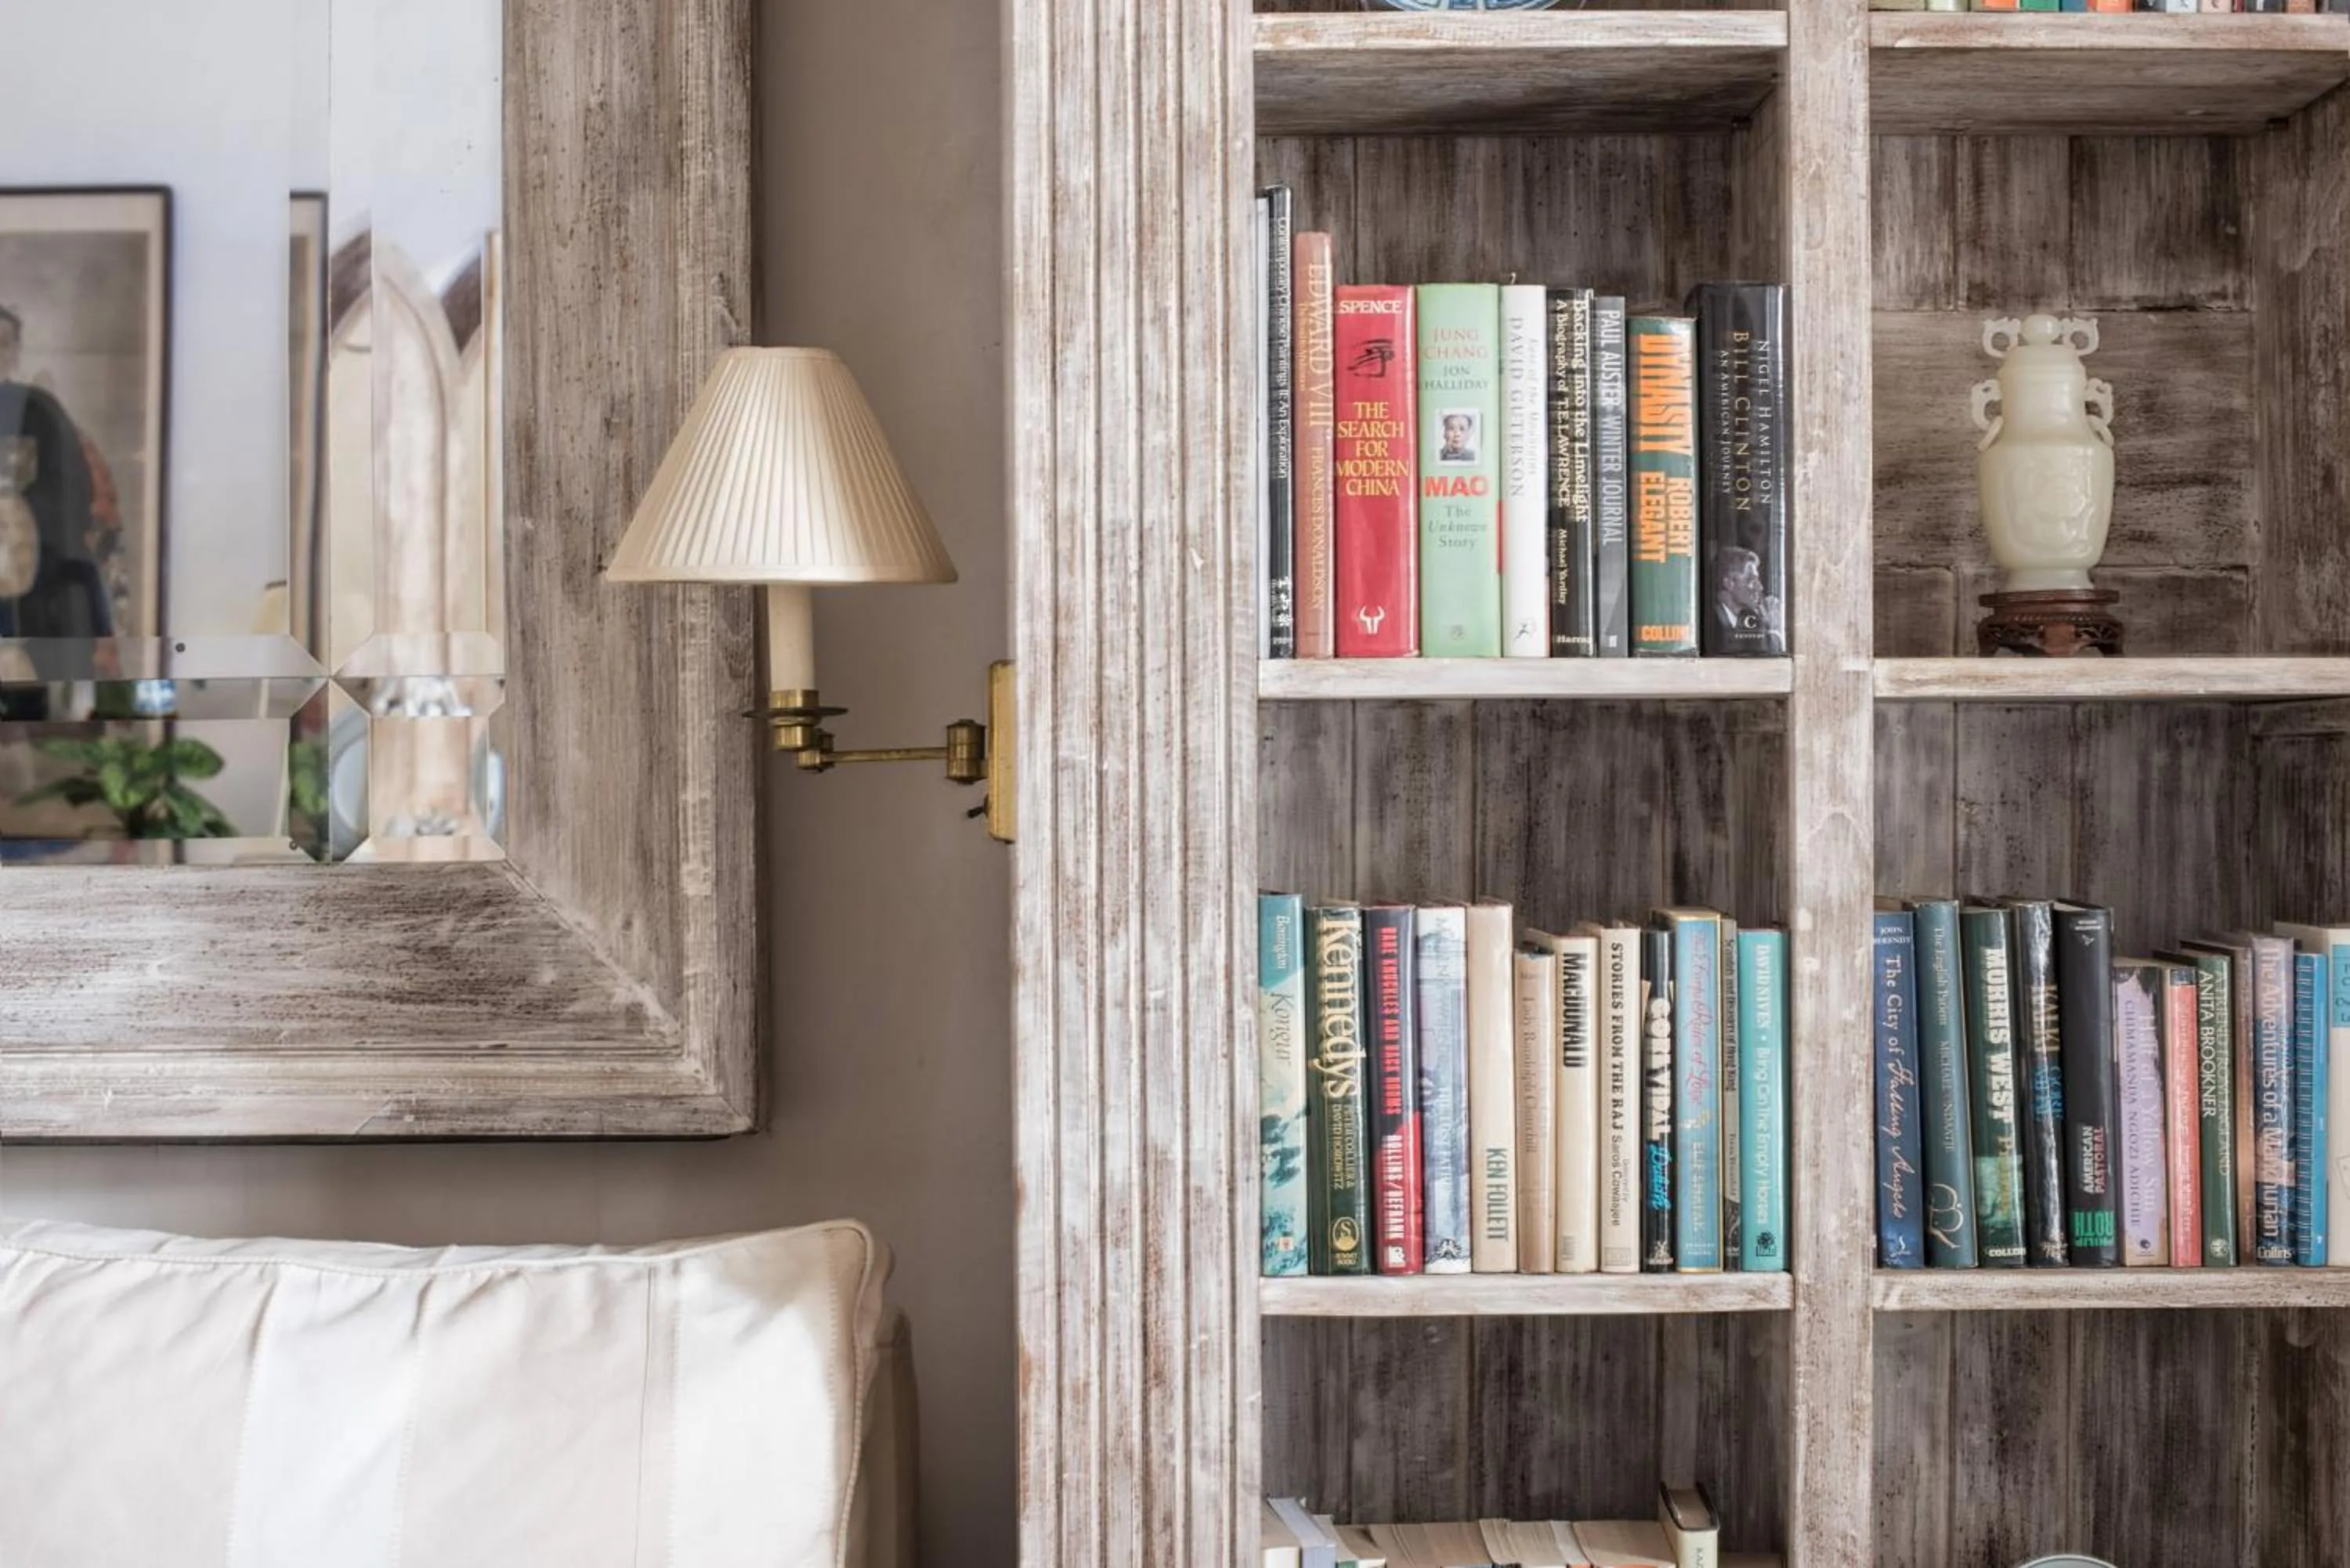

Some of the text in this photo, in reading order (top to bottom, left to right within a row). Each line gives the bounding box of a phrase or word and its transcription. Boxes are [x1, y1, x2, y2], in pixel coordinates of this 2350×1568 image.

[1339, 300, 1402, 313] SPENCE
[1556, 300, 1569, 311] A
[1309, 263, 1333, 427] EDWARD VIII
[1423, 347, 1488, 359] CHANG
[1434, 327, 1479, 342] JUNG
[1555, 314, 1569, 377] Biography
[1421, 379, 1488, 390] HALLIDAY
[1442, 365, 1472, 378] JON
[1559, 379, 1569, 392] of
[1354, 402, 1389, 418] THE
[1509, 316, 1525, 497] DAVID GUTERSON
[1572, 299, 1590, 522] Backing into the Limelight
[1640, 334, 1693, 457] DYNASTY
[1337, 421, 1405, 438] SEARCH
[1600, 310, 1625, 546] PAUL AUSTER WINTER JOURNAL
[1720, 351, 1731, 494] AN AMERICAN JOURNEY
[1733, 331, 1752, 511] BILL CLINTON
[1758, 341, 1773, 504] NIGEL HAMILTON
[1277, 420, 1289, 479] Exploration
[1336, 460, 1409, 477] MODERN
[1356, 439, 1389, 457] FOR
[1346, 479, 1400, 497] CHINA
[1424, 476, 1488, 497] MAO
[1311, 446, 1325, 611] FRANCES DONALDSON
[1427, 520, 1487, 532] Unknown
[1446, 505, 1472, 518] The
[1640, 471, 1667, 563] ELEGANT
[1667, 477, 1694, 558] ROBERT
[1439, 536, 1476, 549] Story
[1558, 529, 1568, 567] Michael
[1933, 926, 1945, 947] The
[1611, 942, 1623, 1010] STORIES
[1755, 945, 1771, 985] DAVID
[1932, 950, 1949, 987] English
[1313, 918, 1366, 1097] Kennedys
[1380, 927, 1403, 1115] BARE KNUCKLES AND BACK ROOMS
[1756, 987, 1772, 1028] NIVEN
[1611, 1015, 1624, 1057] FROM
[1985, 948, 2016, 1123] MORRIS WEST
[2200, 970, 2217, 1118] ANITA BROOKNER
[1611, 1061, 1624, 1094] THE
[1757, 1083, 1771, 1105] On
[1882, 954, 1915, 1218] The City of Falling Angels
[2261, 948, 2285, 1237] The Adventures of a Manchurian
[1332, 1104, 1343, 1135] DAVID
[1611, 1098, 1624, 1130] RAJ
[1650, 1069, 1672, 1141] VIDAL
[2124, 1000, 2142, 1227] CHIMAMANDA NGOZI ADICHIE
[1611, 1134, 1622, 1168] Saros
[1752, 1133, 1771, 1176] Empty
[2140, 1104, 2161, 1166] Yellow
[2081, 1125, 2094, 1194] AMERICAN
[2093, 1125, 2106, 1194] PASTORAL
[1486, 1147, 1509, 1242] KEN FOLLETT
[2142, 1176, 2162, 1212] Sun
[2074, 1210, 2115, 1237] ROTH
